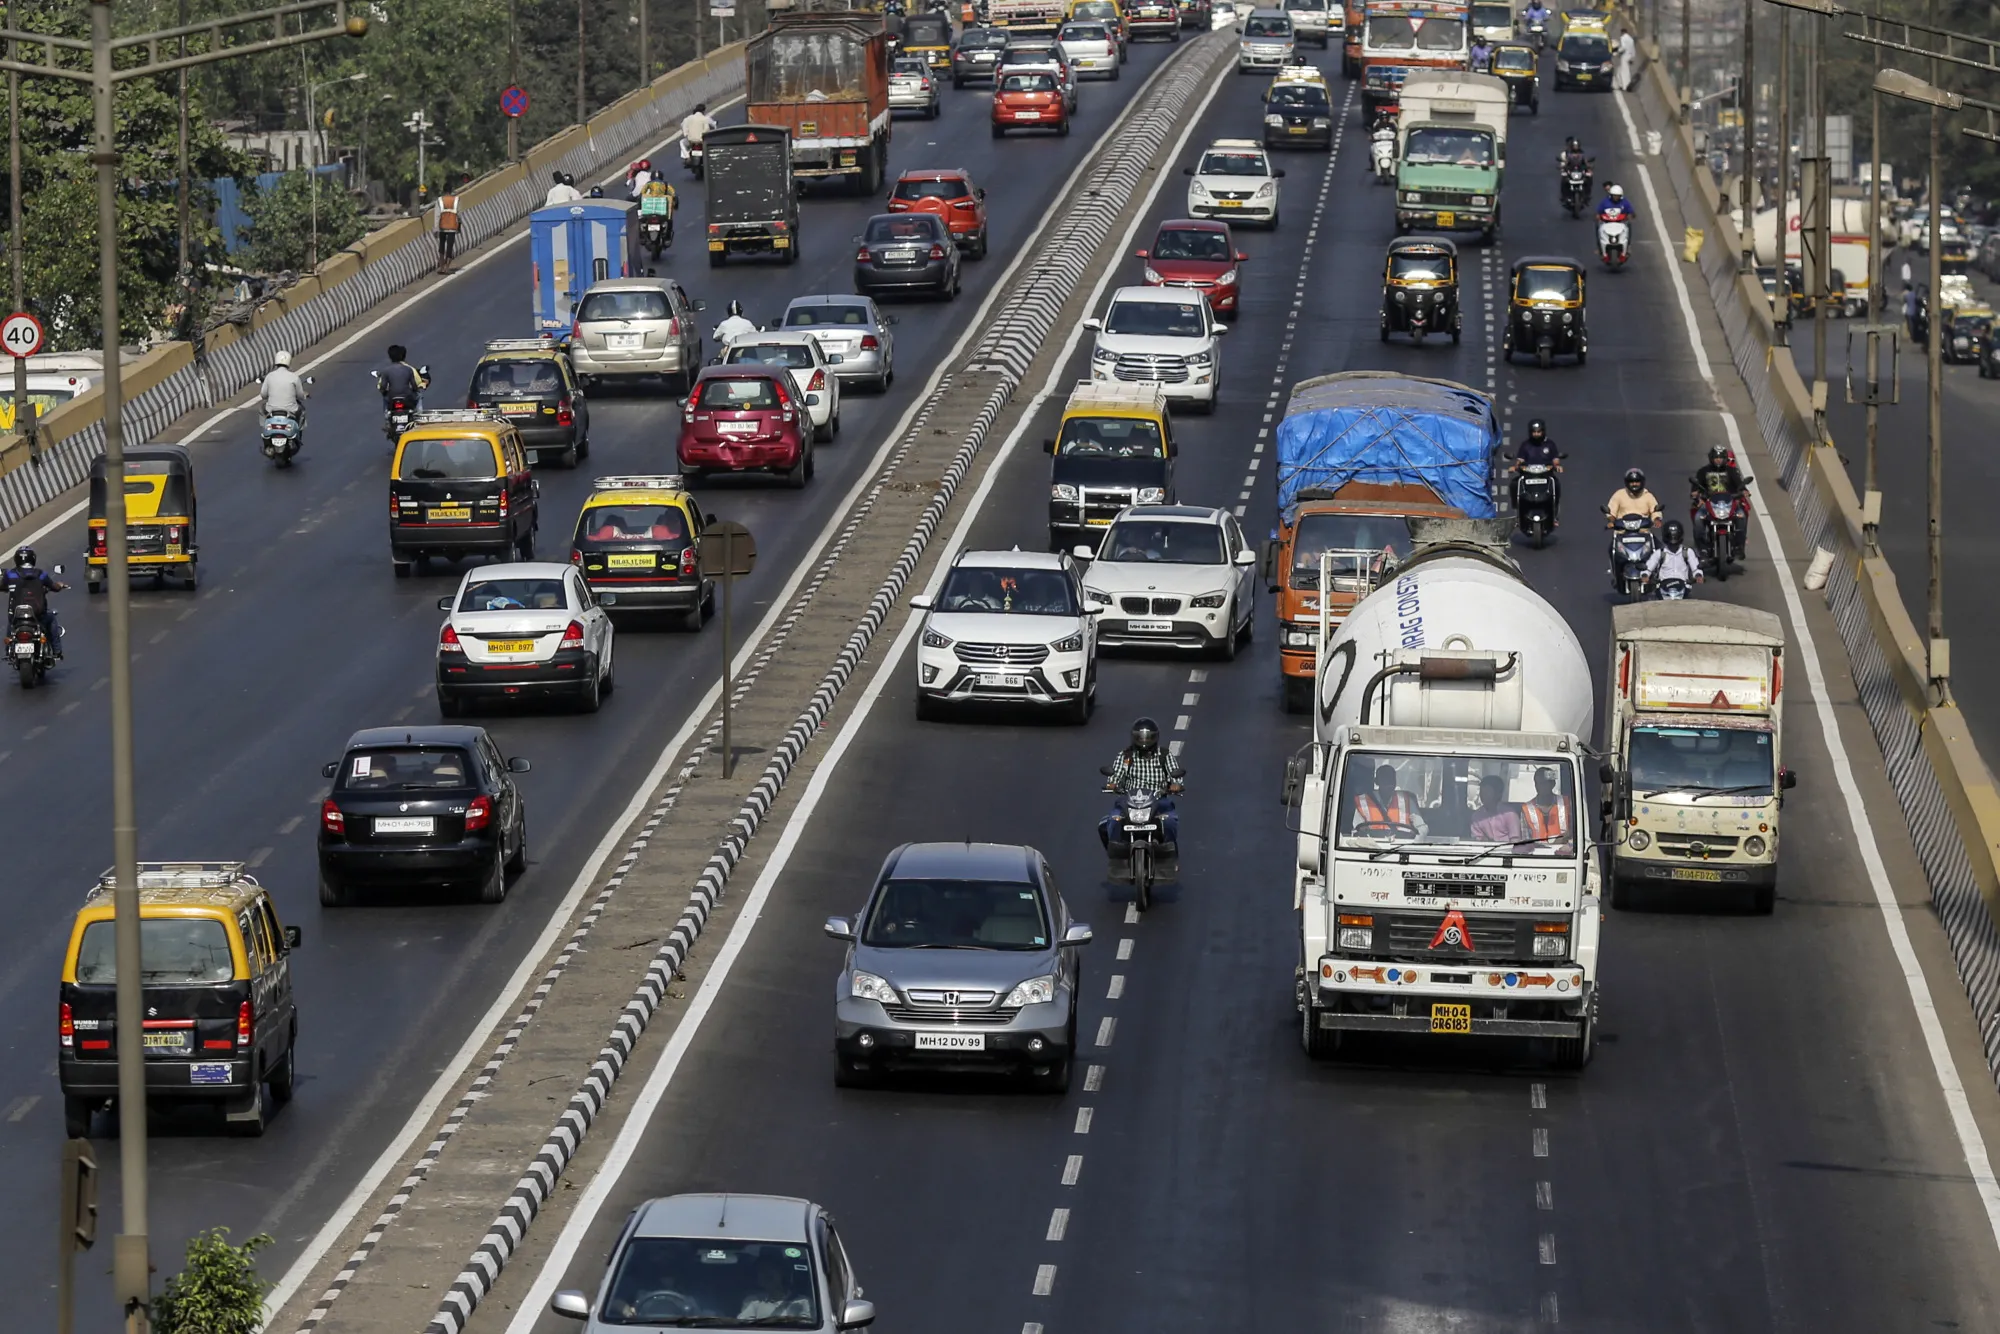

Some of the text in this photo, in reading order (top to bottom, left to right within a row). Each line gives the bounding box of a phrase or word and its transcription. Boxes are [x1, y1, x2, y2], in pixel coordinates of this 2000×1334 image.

[7, 327, 35, 344] 40
[518, 643, 534, 651] 8977
[1005, 677, 1018, 685] 666
[355, 760, 368, 775] L
[1432, 1018, 1468, 1031] GR6183
[968, 1038, 980, 1047] 99
